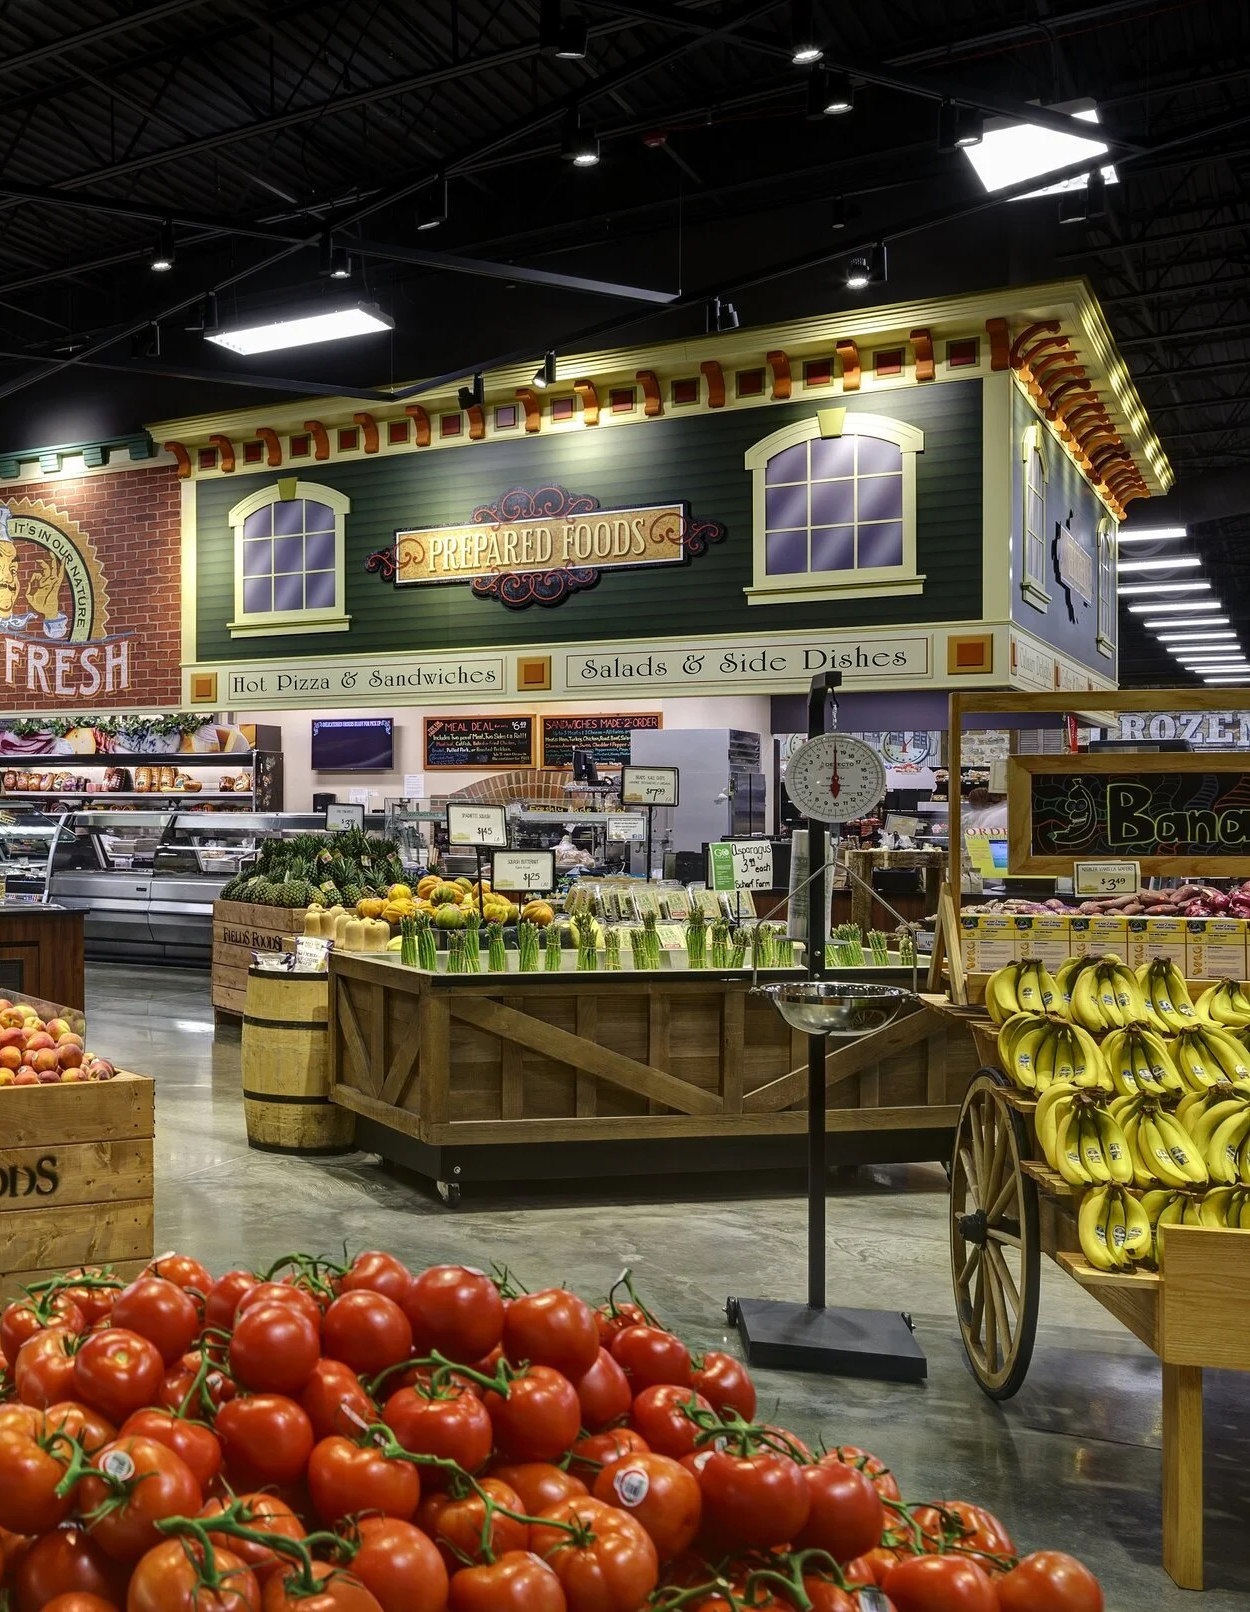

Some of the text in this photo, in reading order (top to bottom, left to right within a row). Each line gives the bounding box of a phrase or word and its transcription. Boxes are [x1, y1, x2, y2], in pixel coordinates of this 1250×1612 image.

[428, 518, 646, 573] PREPARED FOODS
[14, 522, 86, 628] IT'S IN OUR NATURE
[5, 638, 130, 696] FRESH
[581, 645, 908, 679] Salads & Side Dishes
[233, 665, 496, 693] Hot Pizza & Sandwiches
[445, 722, 468, 732] MEAL
[472, 721, 495, 731] DEAL
[545, 720, 598, 730] SANDWICHES
[1120, 713, 1250, 746] ROZEN
[1107, 783, 1250, 846] Bana
[755, 863, 771, 873] each
[755, 879, 771, 888] Farm
[223, 927, 282, 951] FIELDS FOODS
